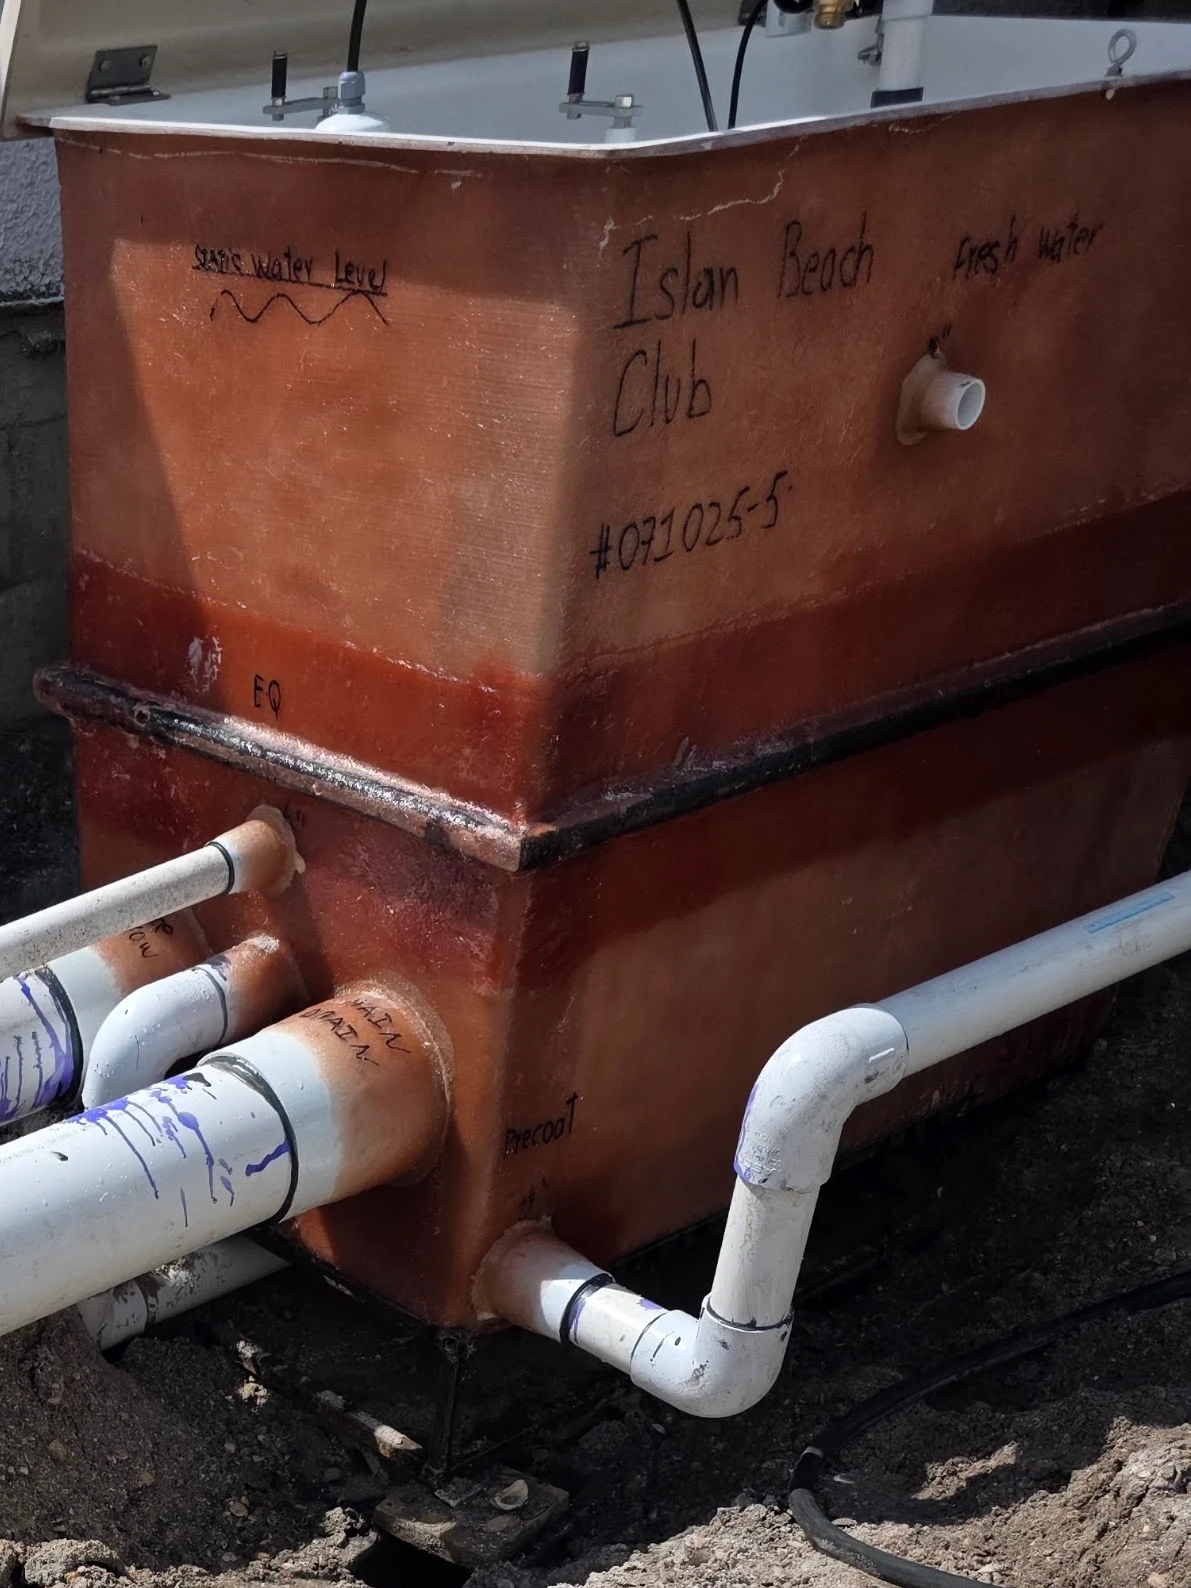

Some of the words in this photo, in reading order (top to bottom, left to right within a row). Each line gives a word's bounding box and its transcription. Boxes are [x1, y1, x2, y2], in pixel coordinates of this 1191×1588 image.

[335, 250, 388, 292] Level
[614, 231, 740, 330] Islan
[778, 211, 875, 299] Beach
[613, 339, 713, 438] Club
[299, 1008, 380, 1067] DRAIN
